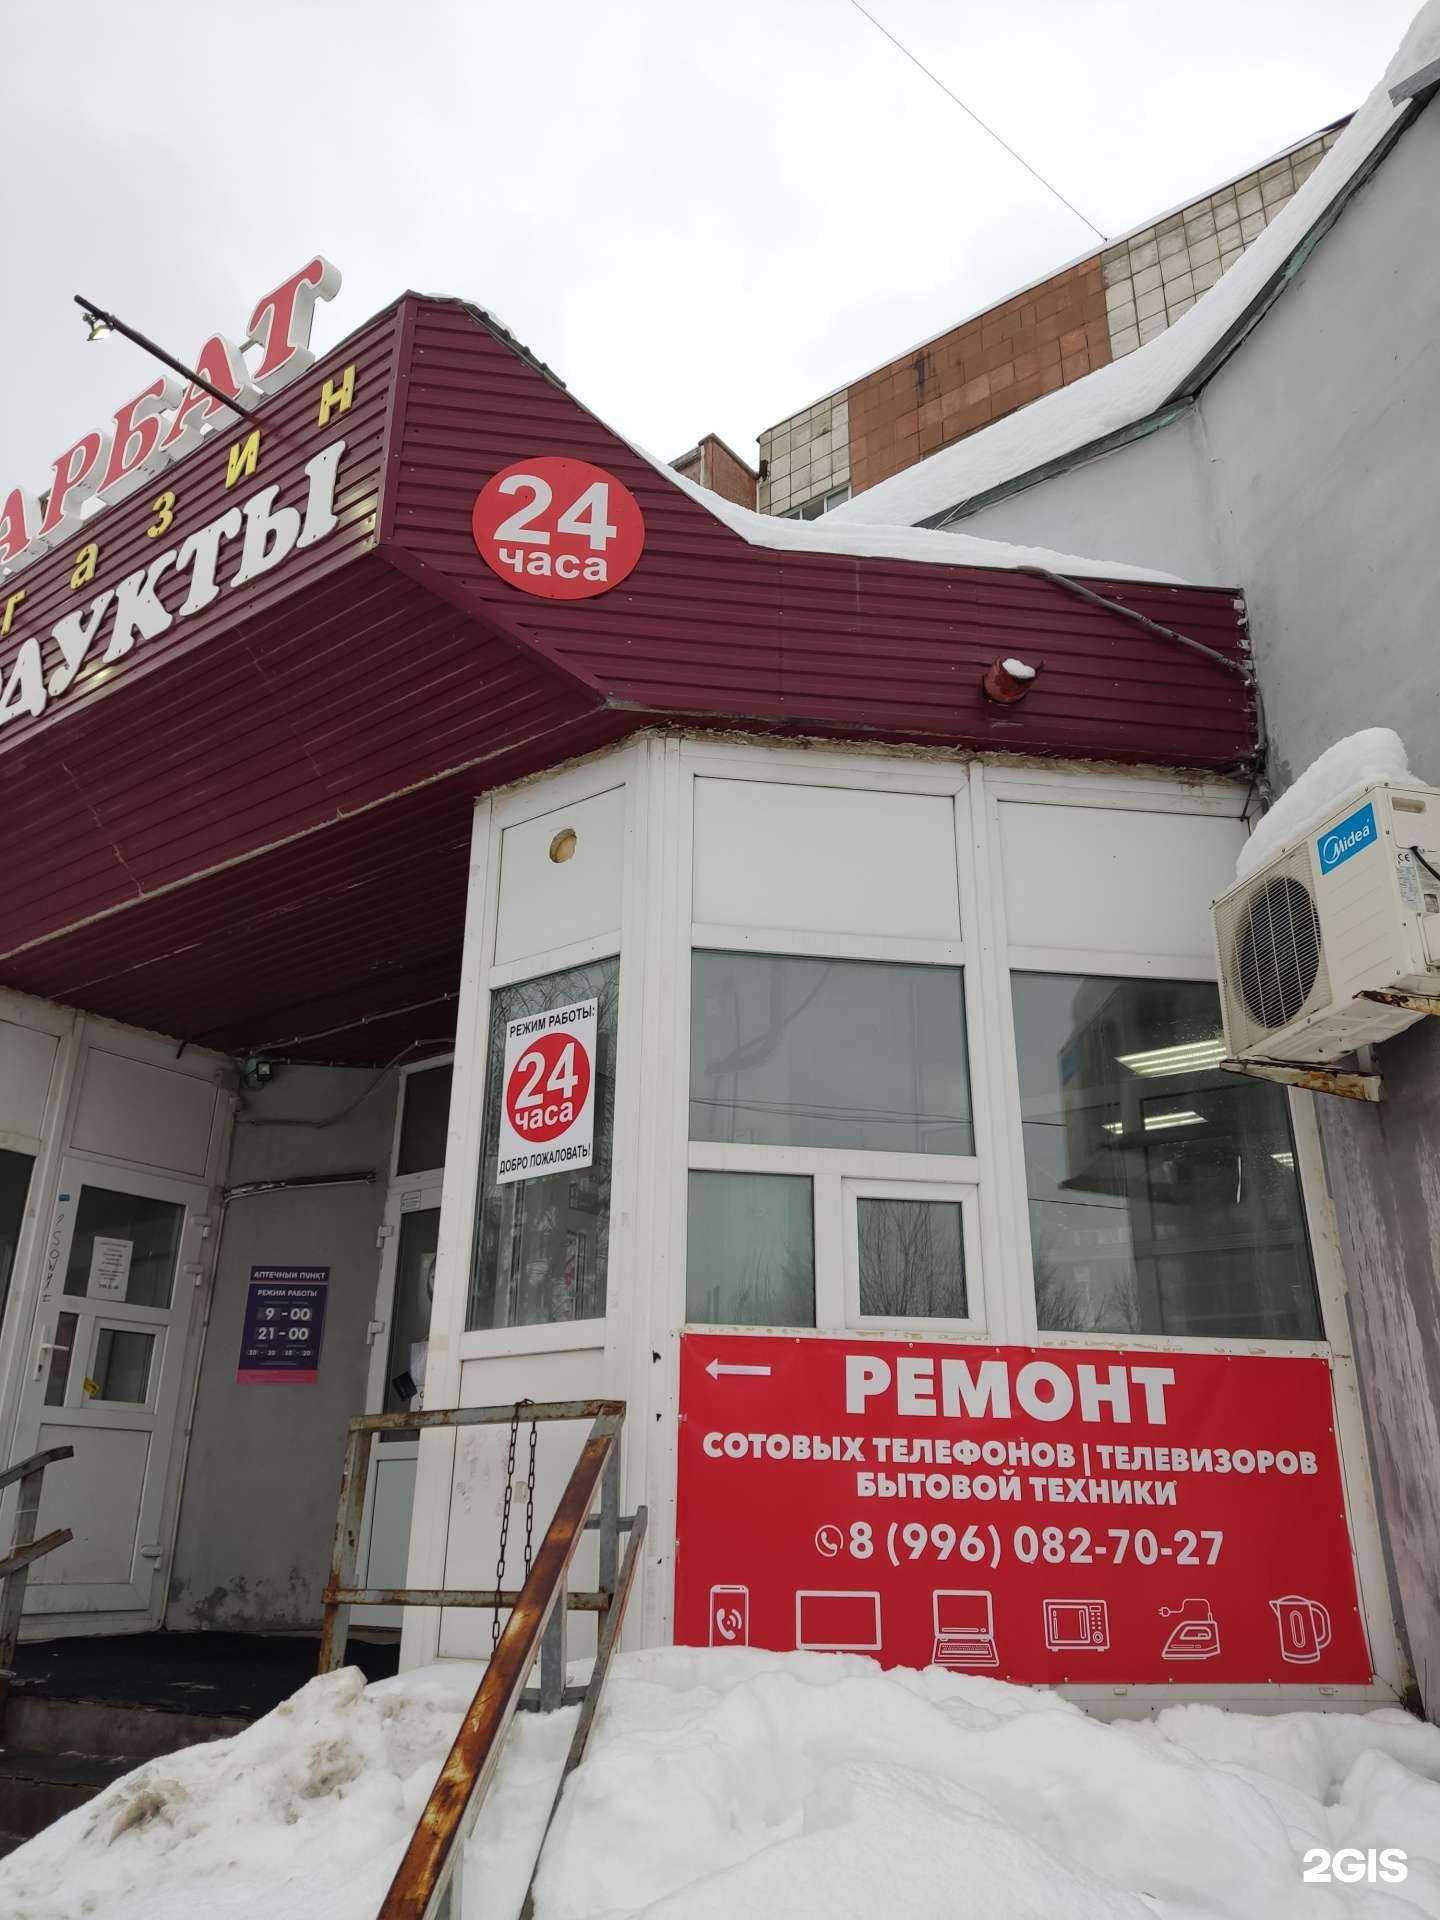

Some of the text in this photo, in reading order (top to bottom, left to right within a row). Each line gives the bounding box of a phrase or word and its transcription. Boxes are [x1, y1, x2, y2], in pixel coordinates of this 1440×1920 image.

[0, 255, 340, 568] АРБАТ
[493, 474, 617, 551] 24
[498, 547, 608, 582] часа
[1323, 825, 1370, 864] Midea
[509, 1005, 595, 1038] РЕЖИМ РАБОТЫ:
[514, 1042, 579, 1110] 24
[515, 1101, 573, 1131] часа
[499, 1144, 591, 1175] ДОБРО ПОЖАЛОВАТЬ!
[257, 1289, 317, 1297] РЕЖИМ РАБОТЫ
[299, 1272, 326, 1280] ПУНКТ
[845, 1355, 1176, 1425] РЕМОНТ
[702, 1432, 866, 1461] СОТОВЫХ
[872, 1437, 1076, 1468] ТЕЛЕФОНОВ
[1096, 1445, 1318, 1475] ТЕЛЕВИЗОРОВ
[856, 1469, 1177, 1506] БЫТОВОЙ ТЕХНИКИ
[849, 1521, 1224, 1568] 8 (996) 082-70-27
